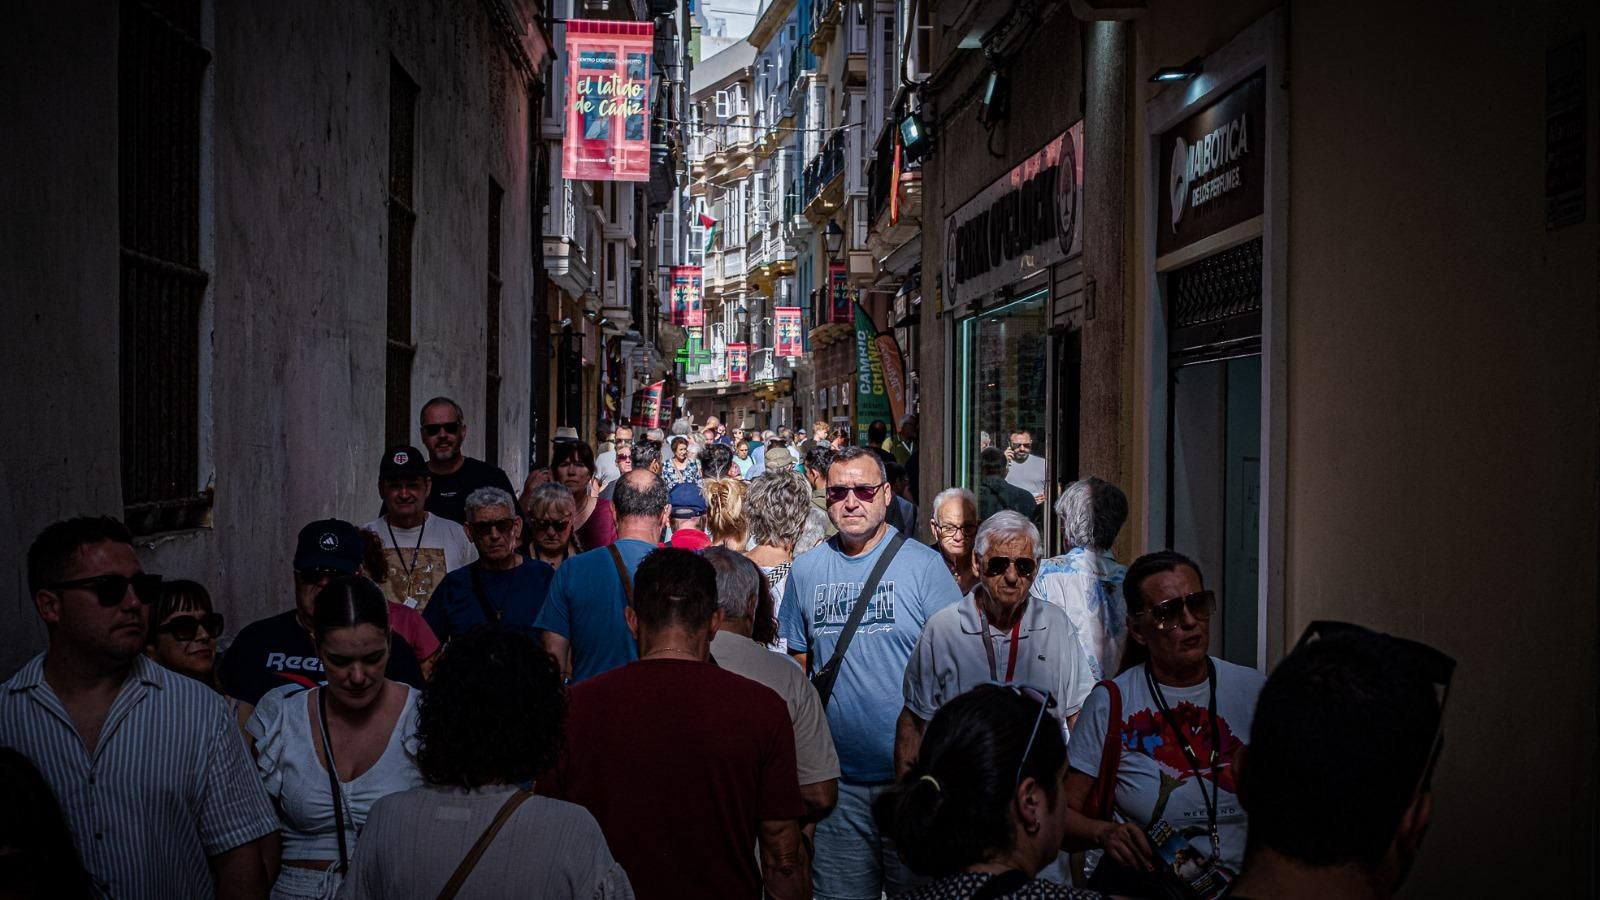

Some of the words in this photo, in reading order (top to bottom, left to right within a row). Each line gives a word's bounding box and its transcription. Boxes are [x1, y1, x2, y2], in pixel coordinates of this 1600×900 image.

[577, 76, 593, 95] El
[598, 73, 644, 98] latido
[574, 96, 596, 115] de
[599, 97, 644, 119] Cádiz
[1204, 113, 1250, 175] BOTICA
[1183, 807, 1236, 817] WEEEND
